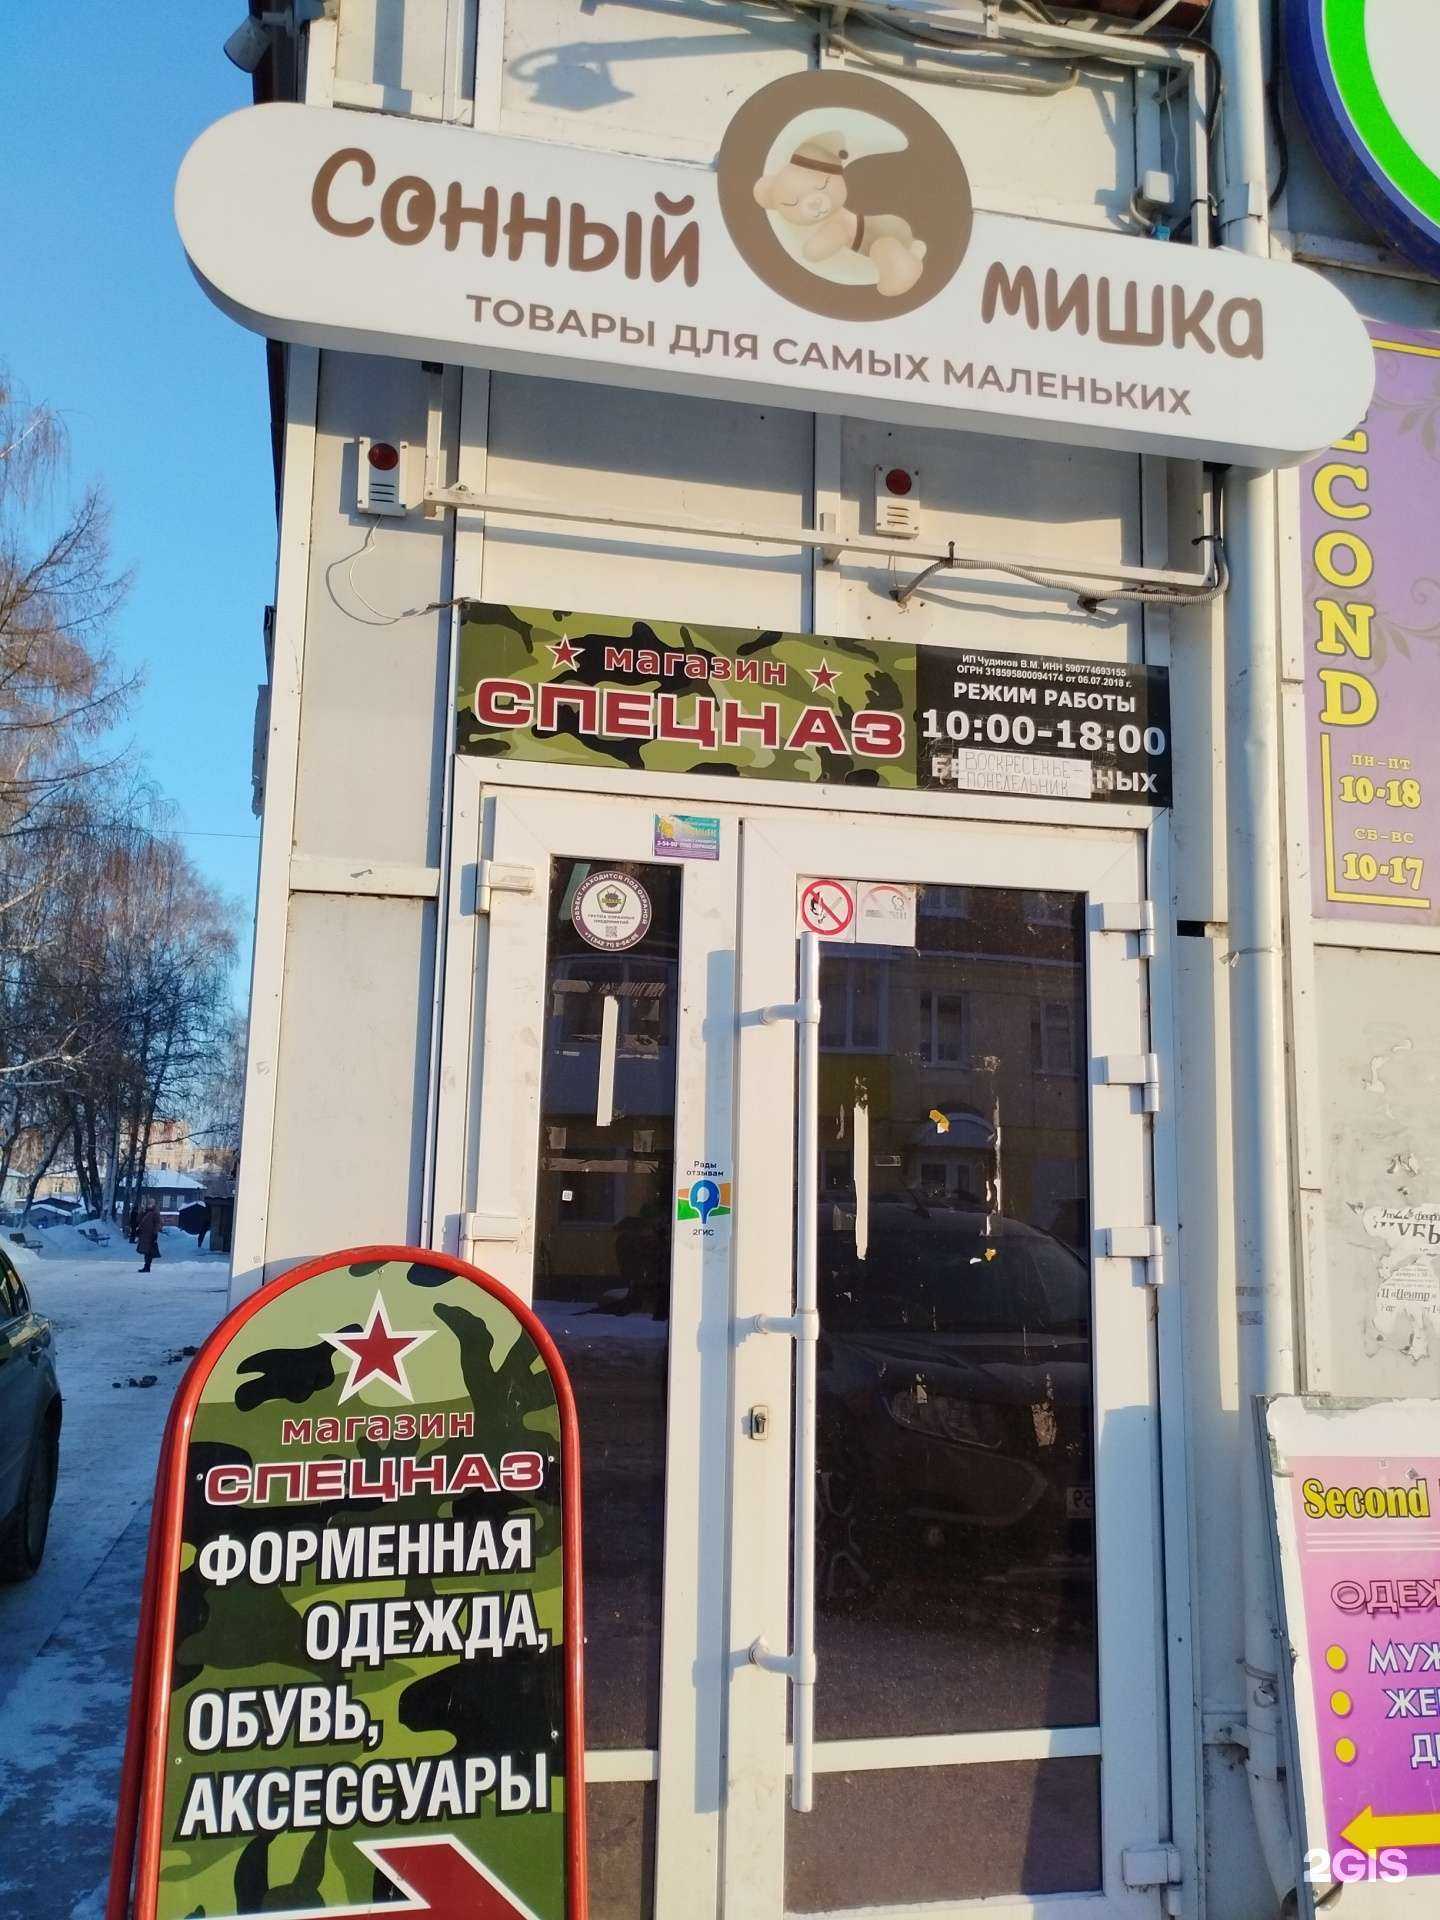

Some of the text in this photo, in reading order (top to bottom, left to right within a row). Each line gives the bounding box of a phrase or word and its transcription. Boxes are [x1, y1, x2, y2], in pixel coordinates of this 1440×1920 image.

[465, 293, 1193, 417] ТОВАРЫ ДЛЯ САМЫХ МАЛЕНЬКИХ
[603, 645, 788, 686] магазин
[956, 664, 983, 675] ОГРН
[1065, 675, 1076, 683] от
[962, 654, 976, 663] ИП
[978, 656, 1018, 667] Чудинов
[1042, 661, 1063, 671] ИНН
[474, 677, 906, 759] СПЕЦНАЗ
[953, 681, 1136, 713] РЕЖИМ РАБОТЫ
[921, 708, 1166, 756] 10:00-18:00
[694, 1160, 717, 1169] Рады
[693, 1228, 715, 1237] 2ГИС
[281, 1411, 475, 1446] магазин
[204, 1451, 544, 1507] СПЕЦНАЗ
[1303, 1478, 1431, 1520] Second
[198, 1518, 533, 1587] ФОРМЕННАЯ
[305, 1593, 549, 1669] ОДЕЖДА,
[187, 1684, 379, 1752] ОБУВЬ,
[1383, 1687, 1440, 1719] ЖЕ
[179, 1752, 549, 1838] АКСЕССУАРЫ
